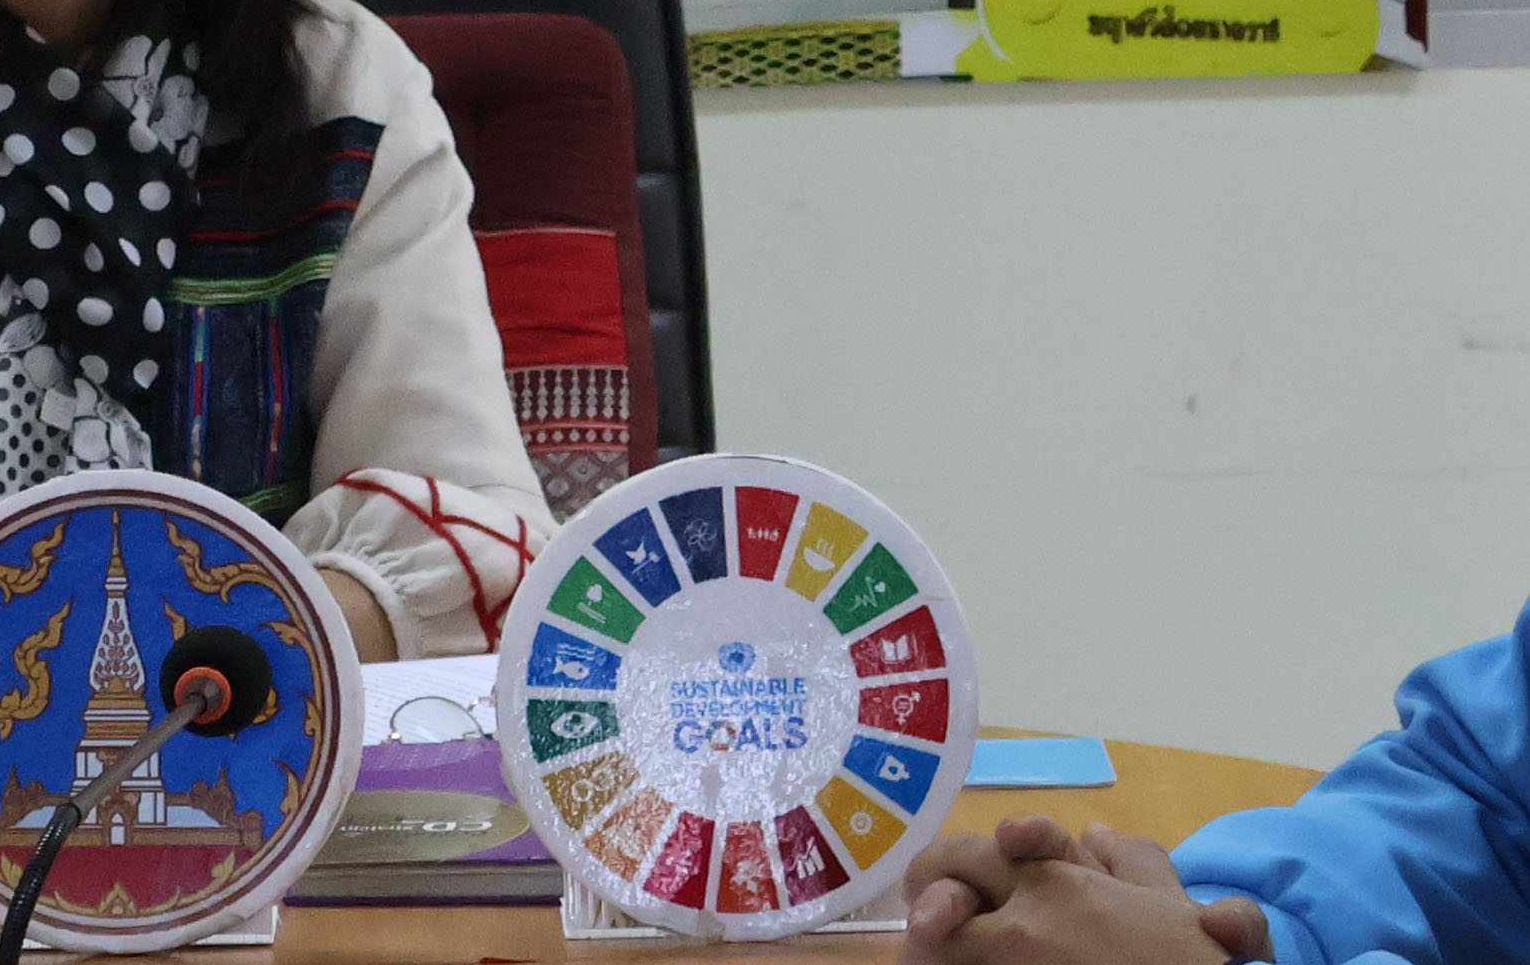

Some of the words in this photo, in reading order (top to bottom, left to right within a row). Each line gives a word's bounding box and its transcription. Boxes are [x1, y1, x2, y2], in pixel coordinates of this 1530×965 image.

[670, 677, 807, 698] SUSTAINABLE
[670, 698, 807, 718] DEVELOPMENT
[673, 716, 808, 754] GOALS
